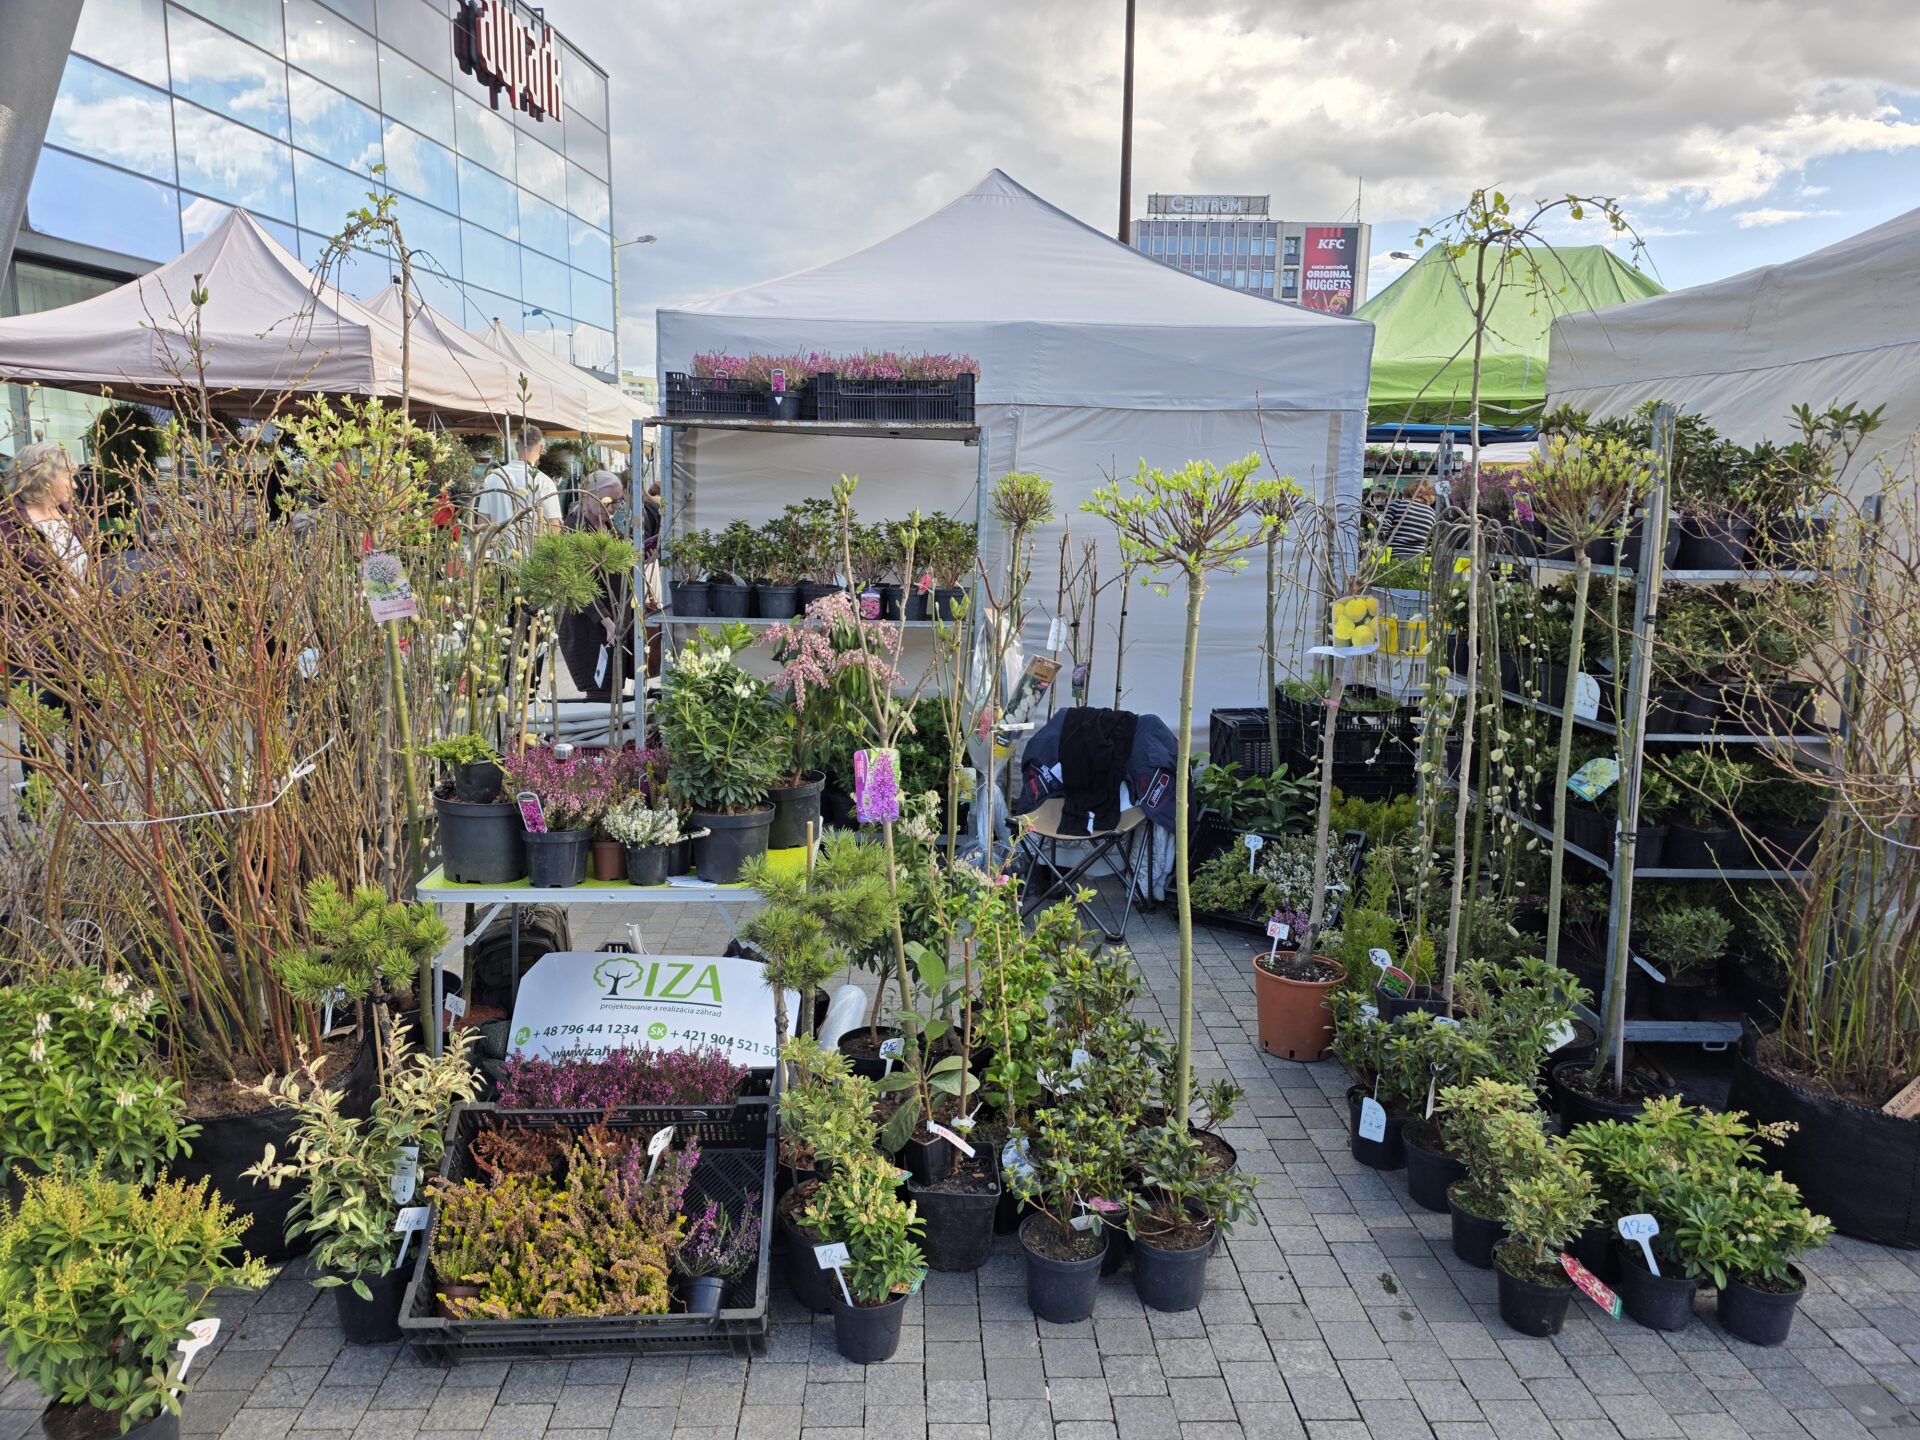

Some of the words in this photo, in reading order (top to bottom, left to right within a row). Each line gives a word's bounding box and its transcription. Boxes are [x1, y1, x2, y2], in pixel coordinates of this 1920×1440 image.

[1317, 238, 1345, 250] KFC
[1307, 270, 1352, 279] ORIGINAL
[1306, 279, 1351, 290] NUGGETS
[644, 962, 723, 1003] IZA
[600, 1003, 652, 1011] projektovanie
[696, 1008, 722, 1017] záhrad
[517, 1029, 529, 1041] PL
[543, 1026, 558, 1036] 48
[561, 1024, 584, 1035] 796
[586, 1024, 603, 1034] 44
[607, 1024, 639, 1035] 1234
[650, 1026, 665, 1036] SK
[682, 1029, 706, 1042] 421
[710, 1033, 734, 1047] 904
[736, 1038, 759, 1053] 521
